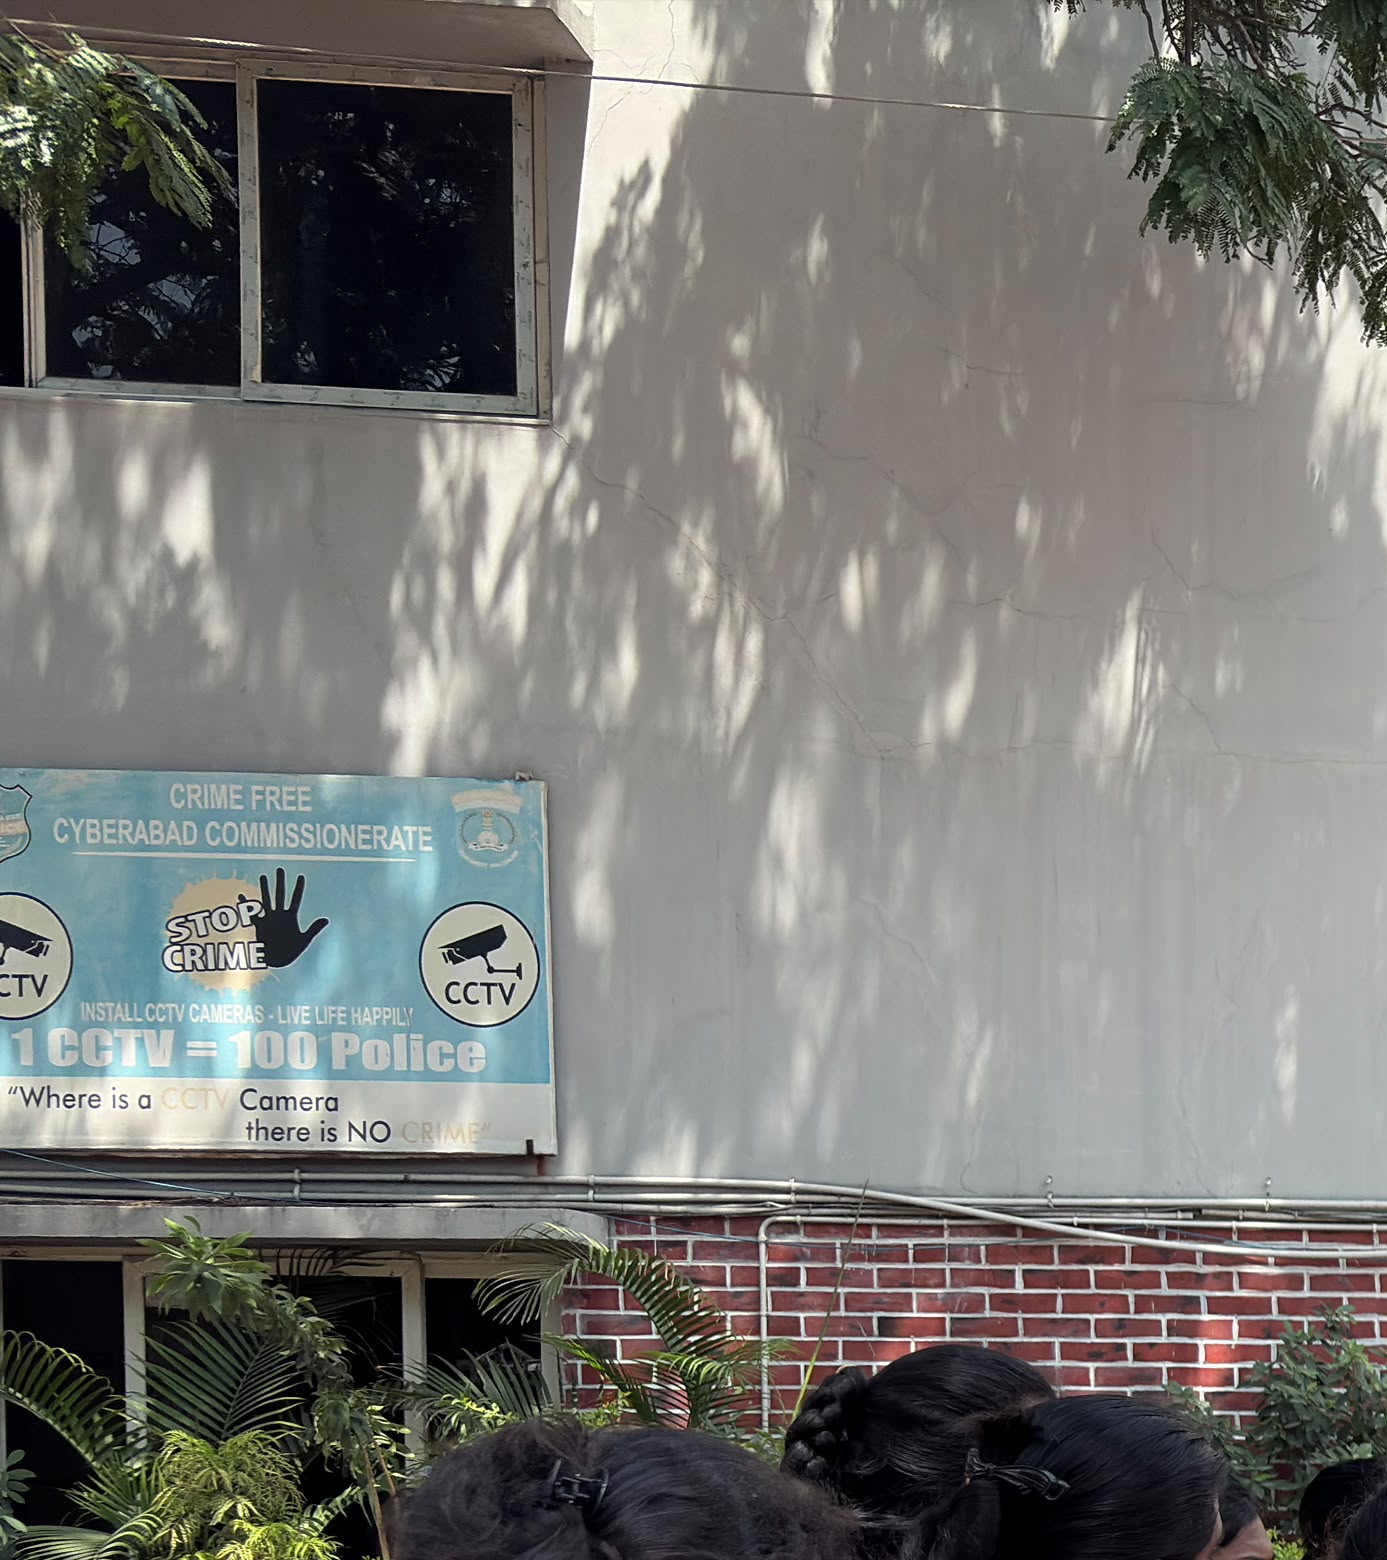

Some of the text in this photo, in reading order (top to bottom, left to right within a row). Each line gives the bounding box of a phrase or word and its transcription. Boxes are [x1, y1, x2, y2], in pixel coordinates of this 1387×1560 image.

[170, 783, 312, 812] CRIME FREE
[53, 817, 433, 852] CYBERABAD COMMISSIONERATE
[166, 899, 266, 943] STOP
[162, 942, 267, 973] CRIME
[0, 973, 48, 997] CTV
[444, 981, 516, 1006] CCTV
[81, 1001, 143, 1022] INSTALL
[145, 1003, 185, 1023] CCTV
[189, 1003, 265, 1024] CAMERAS
[278, 1005, 310, 1025] LIVE
[315, 1006, 347, 1026] LIFE
[351, 1007, 413, 1027] HAPPILY
[11, 1027, 34, 1066] 1
[47, 1027, 175, 1068] CCTV
[227, 1030, 318, 1070] 100
[331, 1031, 486, 1073] Police
[111, 1086, 129, 1110] is
[138, 1094, 152, 1110] a
[160, 1088, 231, 1111] CCTV
[239, 1088, 338, 1112] Camera
[246, 1119, 310, 1143] there
[320, 1120, 337, 1143] is
[348, 1120, 391, 1144] NO
